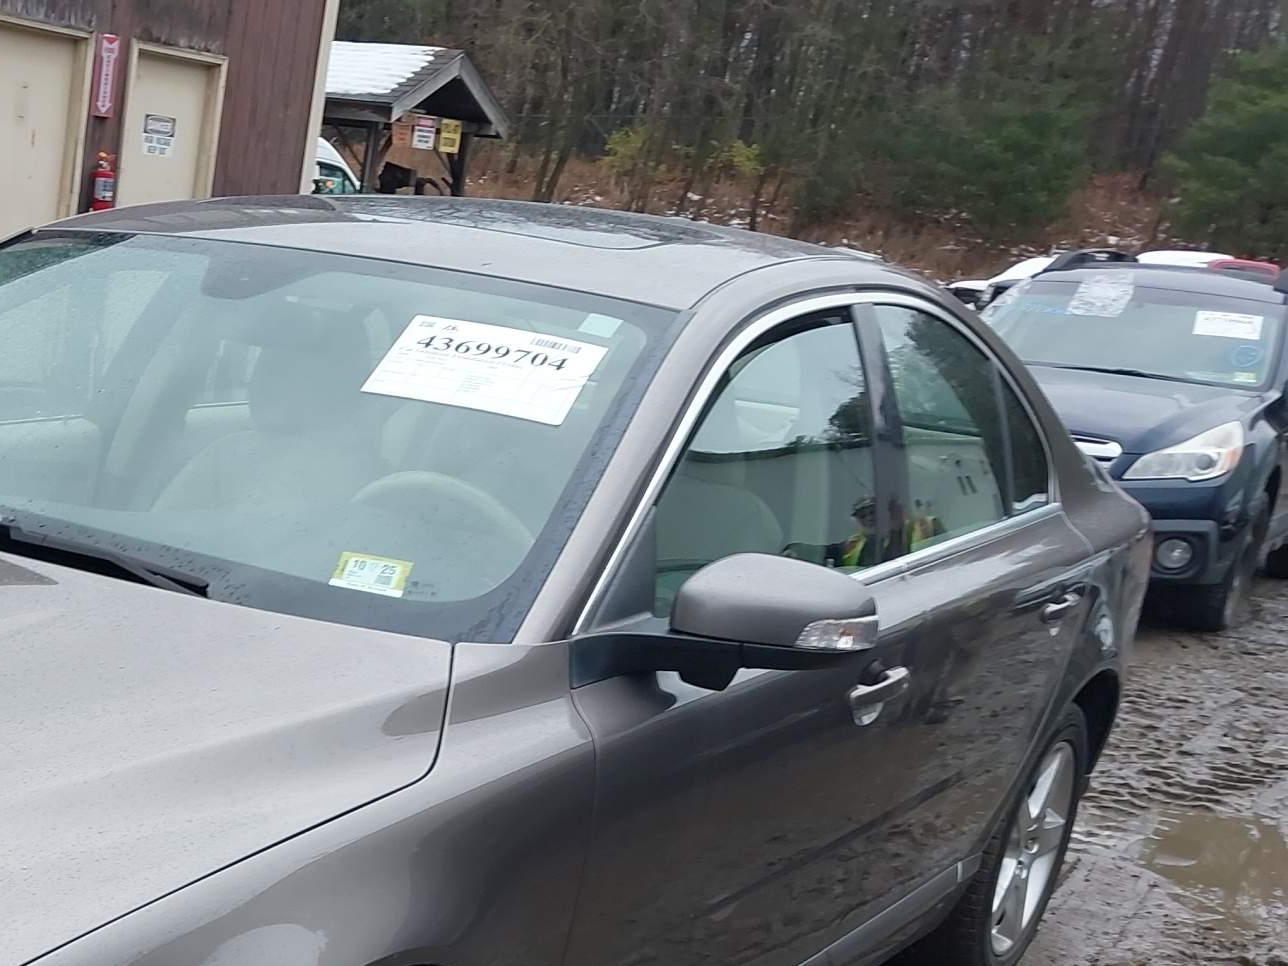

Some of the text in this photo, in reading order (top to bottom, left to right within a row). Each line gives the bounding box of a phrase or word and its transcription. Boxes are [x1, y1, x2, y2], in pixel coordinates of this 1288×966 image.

[416, 335, 569, 371] 43699704
[353, 559, 397, 575] 10 25
